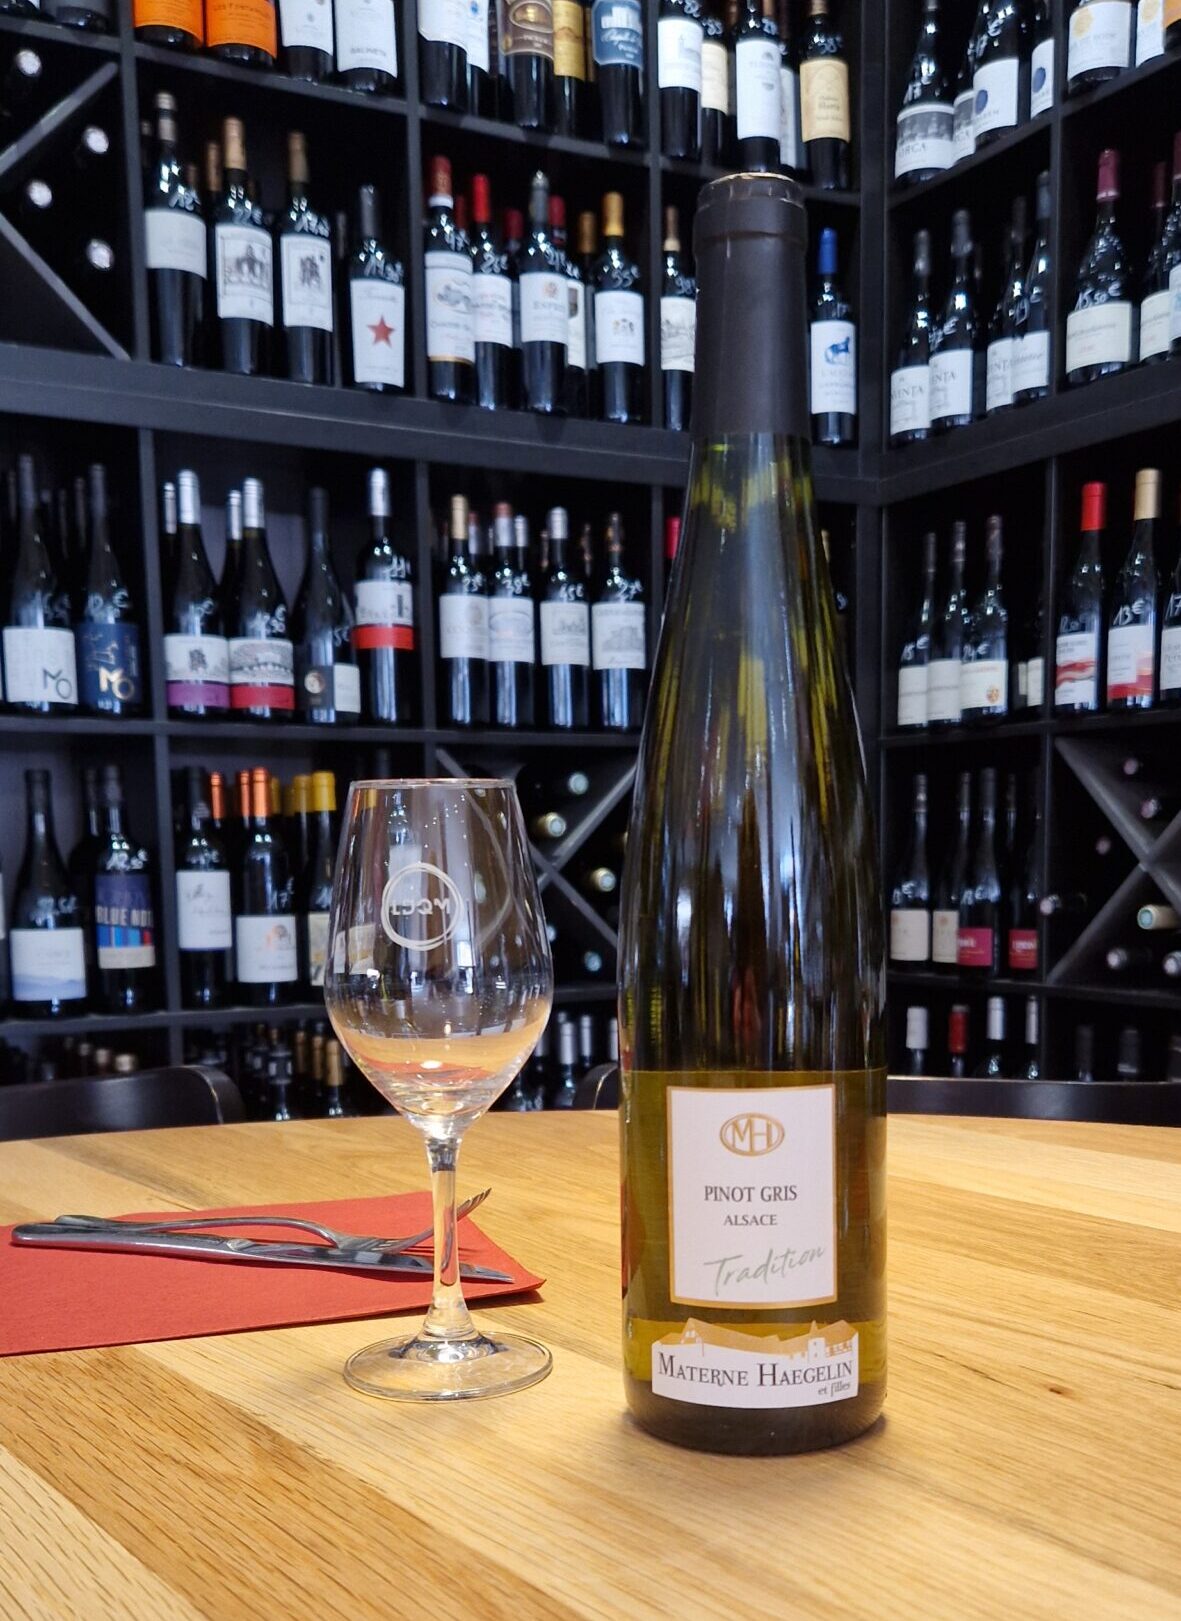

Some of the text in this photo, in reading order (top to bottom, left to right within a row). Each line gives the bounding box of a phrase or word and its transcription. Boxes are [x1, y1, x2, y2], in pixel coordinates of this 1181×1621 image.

[98, 666, 135, 700] MO
[704, 1185, 798, 1203] PINOT GRIS
[723, 1214, 778, 1227] ALSACE
[704, 1246, 827, 1297] Tradition
[818, 1380, 851, 1398] et filles
